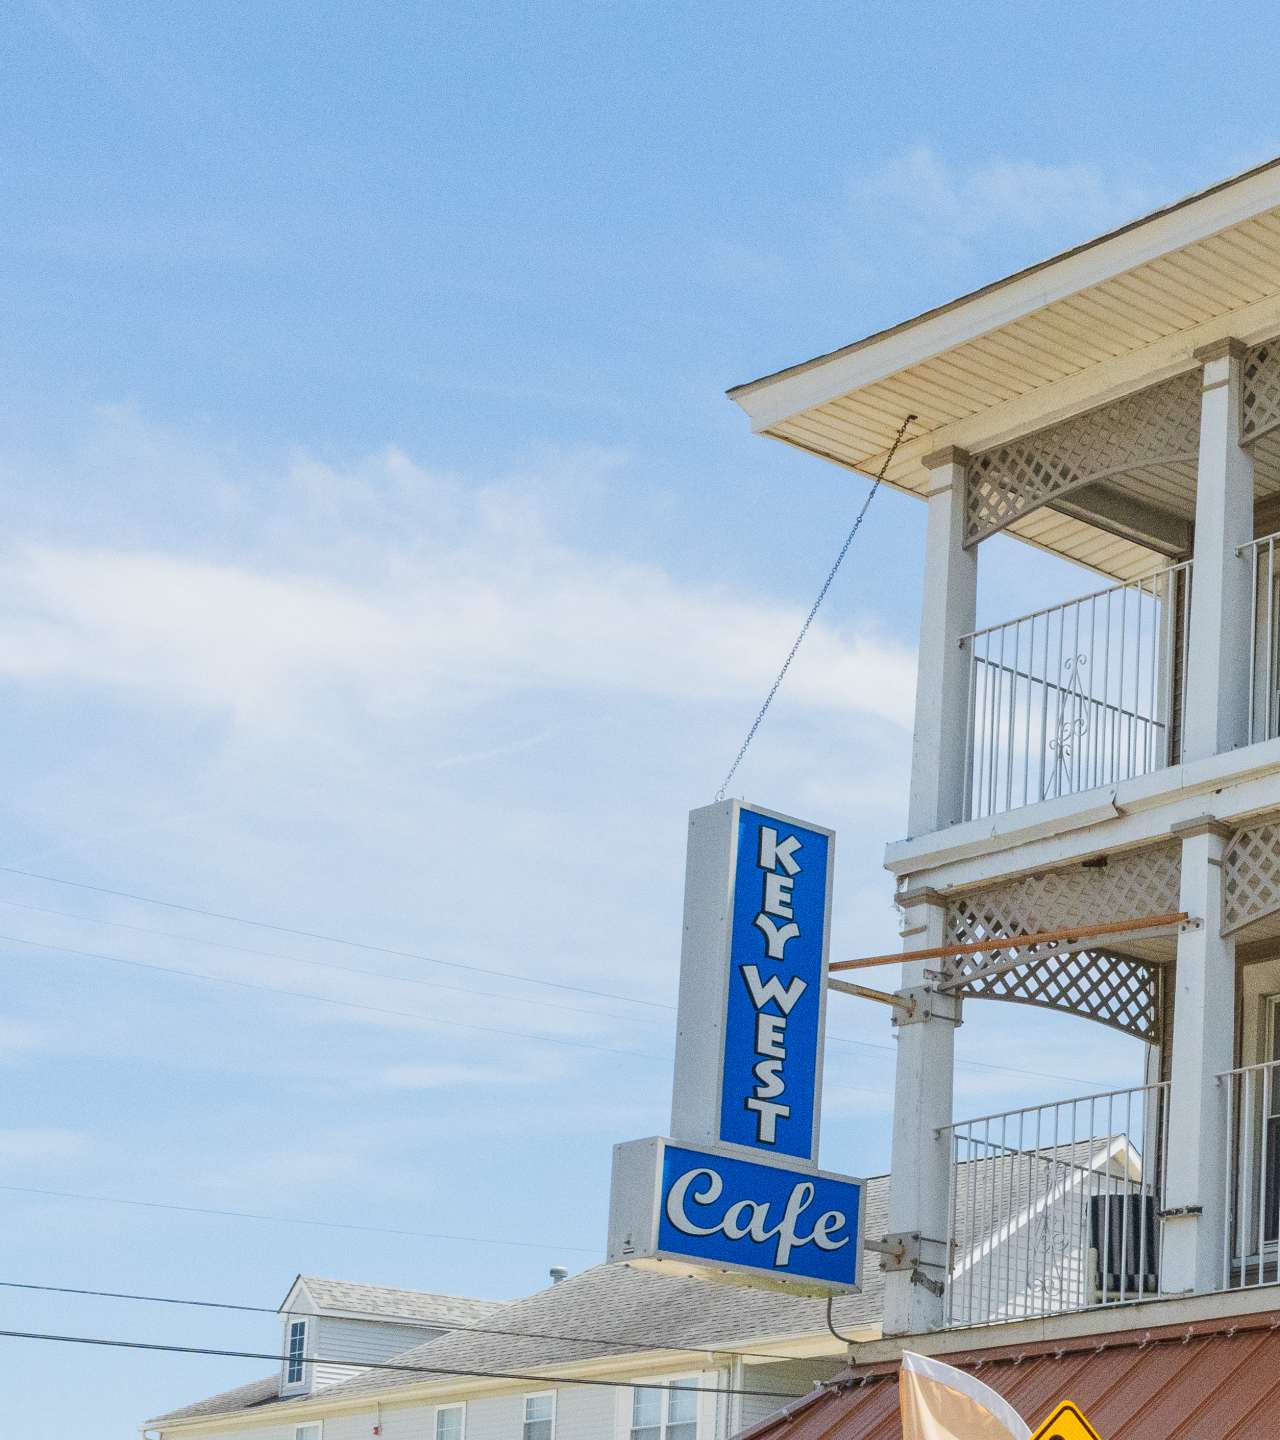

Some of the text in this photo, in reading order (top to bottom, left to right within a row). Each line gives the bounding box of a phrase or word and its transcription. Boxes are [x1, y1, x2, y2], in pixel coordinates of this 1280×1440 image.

[739, 825, 808, 1145] KEY WEST
[665, 1166, 850, 1267] Cafe
